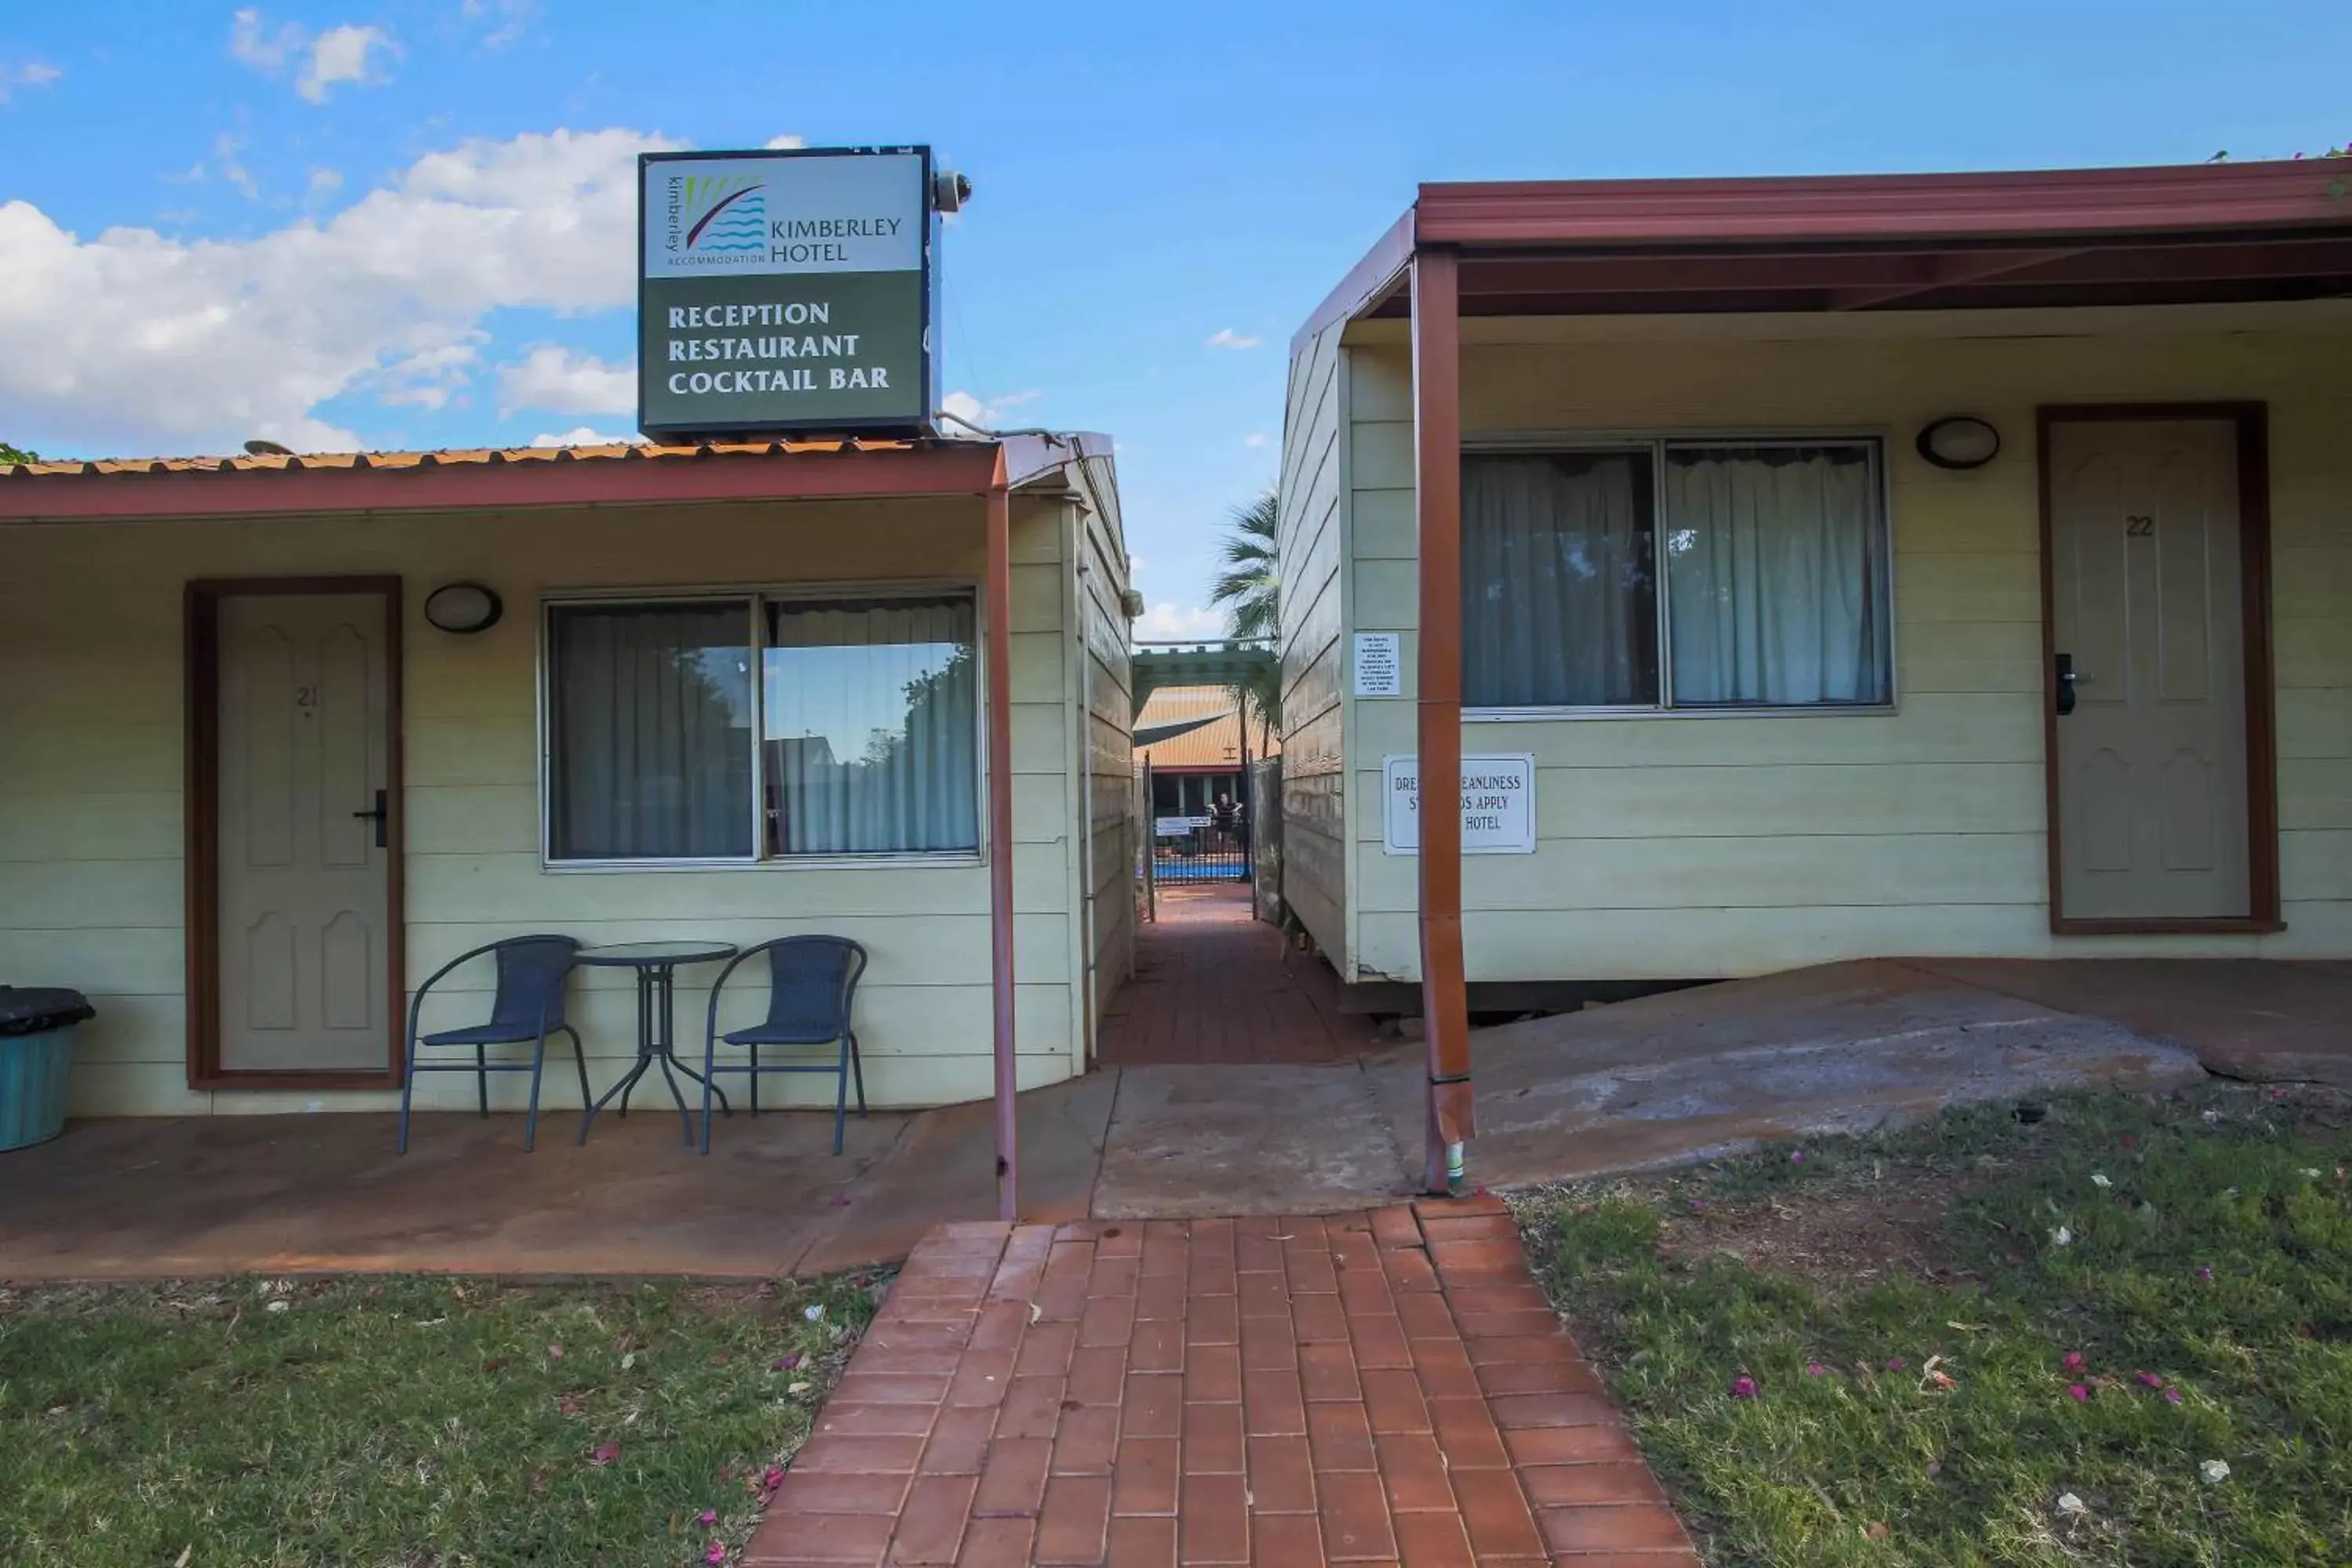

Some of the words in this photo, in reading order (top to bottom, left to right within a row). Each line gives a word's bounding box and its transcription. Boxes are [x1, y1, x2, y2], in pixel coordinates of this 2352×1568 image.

[666, 176, 684, 252] kimberley
[771, 218, 901, 238] KIMBERLEY
[667, 254, 766, 266] ACCOMMODATION
[771, 244, 848, 263] HOTEL
[669, 303, 829, 328] RECEPTION
[669, 335, 859, 361] RESTAURANT
[669, 369, 818, 394] COCKTAIL
[829, 367, 890, 390] BAR
[2125, 515, 2153, 539] 22
[298, 685, 318, 708] 21
[1462, 775, 1521, 790] EANLINESS
[1476, 795, 1508, 811] APPLY
[1465, 815, 1501, 830] HOTEL
